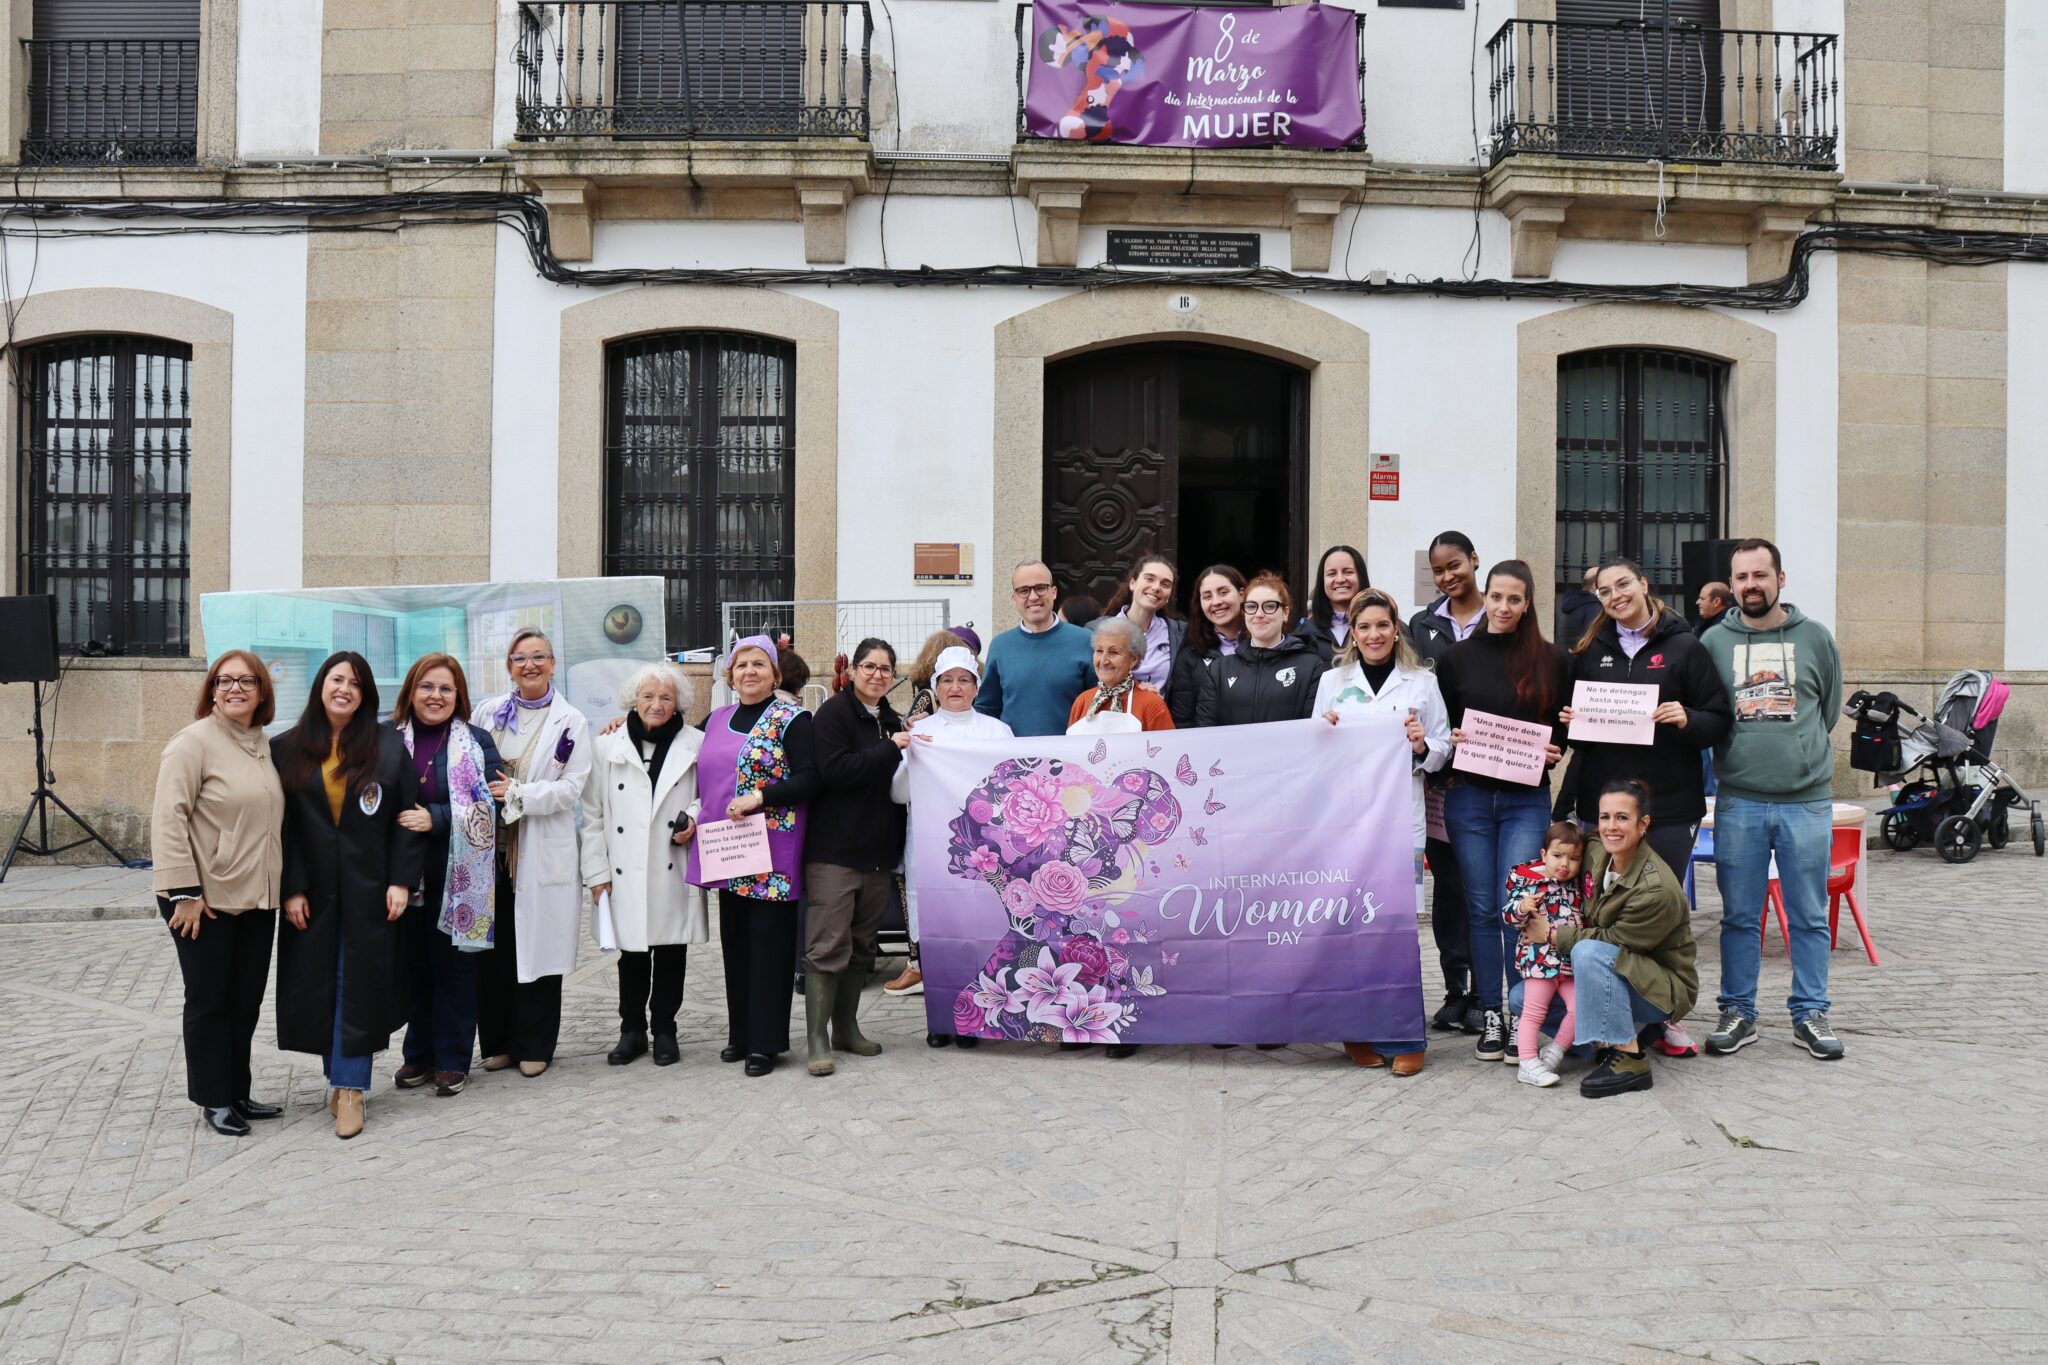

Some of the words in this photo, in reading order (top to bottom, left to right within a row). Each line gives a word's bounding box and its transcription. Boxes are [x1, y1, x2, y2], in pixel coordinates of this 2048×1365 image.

[1214, 12, 1236, 62] 8
[1241, 29, 1260, 44] de
[1187, 56, 1266, 90] Marzo
[1186, 89, 1263, 109] Internacional
[1267, 89, 1285, 105] de
[1286, 88, 1298, 104] la
[1182, 112, 1291, 139] MUJER
[1179, 296, 1189, 308] 16
[1610, 688, 1647, 696] detengas
[1495, 723, 1519, 732] mujer
[1521, 727, 1542, 737] debe
[1490, 732, 1505, 740] dos
[1507, 737, 1535, 747] cosas:
[1464, 739, 1487, 747] quien
[1489, 743, 1504, 751] ella
[1507, 749, 1533, 758] quiera
[1471, 751, 1486, 759] que
[1488, 755, 1503, 763] ella
[705, 826, 725, 834] Nunca
[731, 830, 762, 840] capacidad
[721, 854, 747, 862] quieras.
[1209, 868, 1354, 890] INTERNATIONAL
[1158, 883, 1384, 936] Women's
[1267, 931, 1303, 946] DAY
